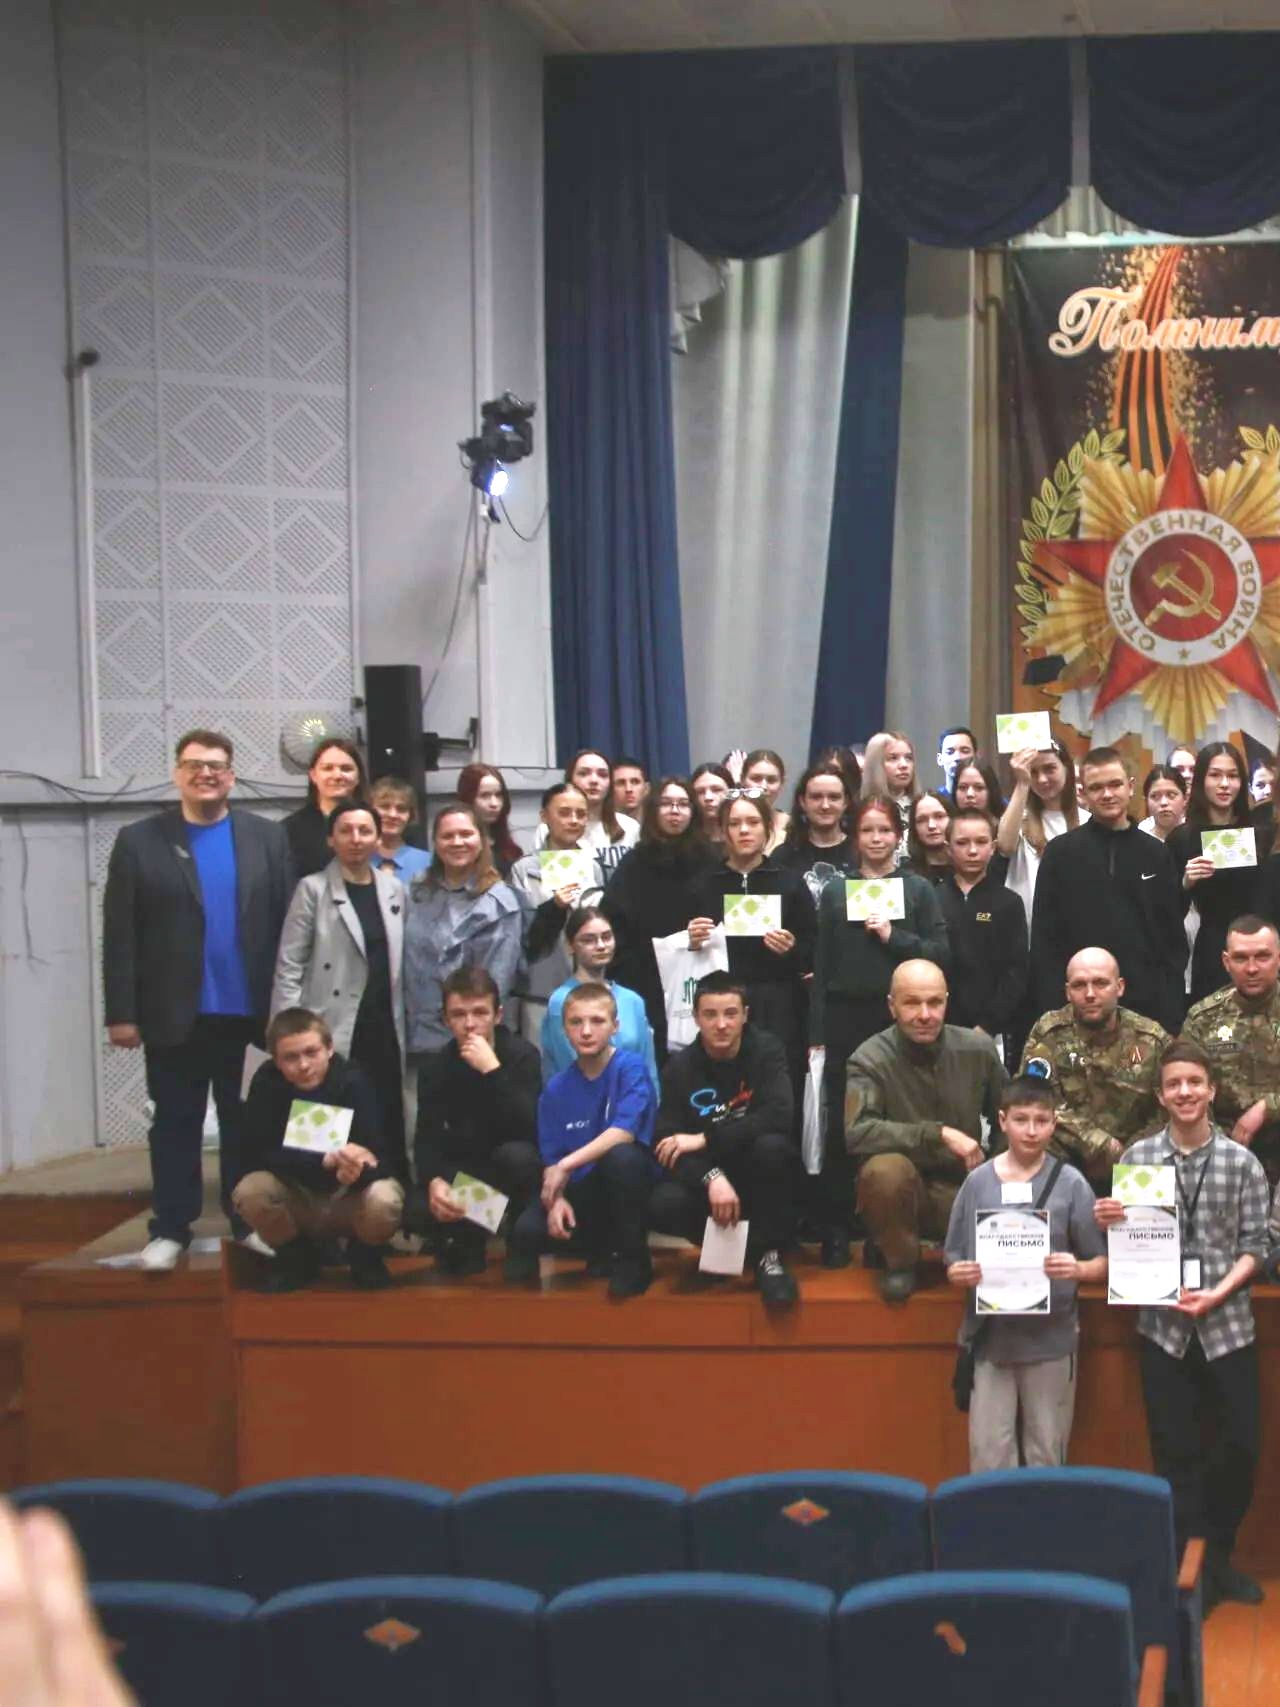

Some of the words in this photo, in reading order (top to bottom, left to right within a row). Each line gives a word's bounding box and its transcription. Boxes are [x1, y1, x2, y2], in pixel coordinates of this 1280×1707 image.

[1109, 513, 1242, 651] ОТЕЧЕСТВЕННАЯ
[1210, 559, 1256, 650] ВОЙНА
[1128, 1232, 1175, 1241] ПИСЬМО
[997, 1239, 1045, 1248] ПИСЬМО
